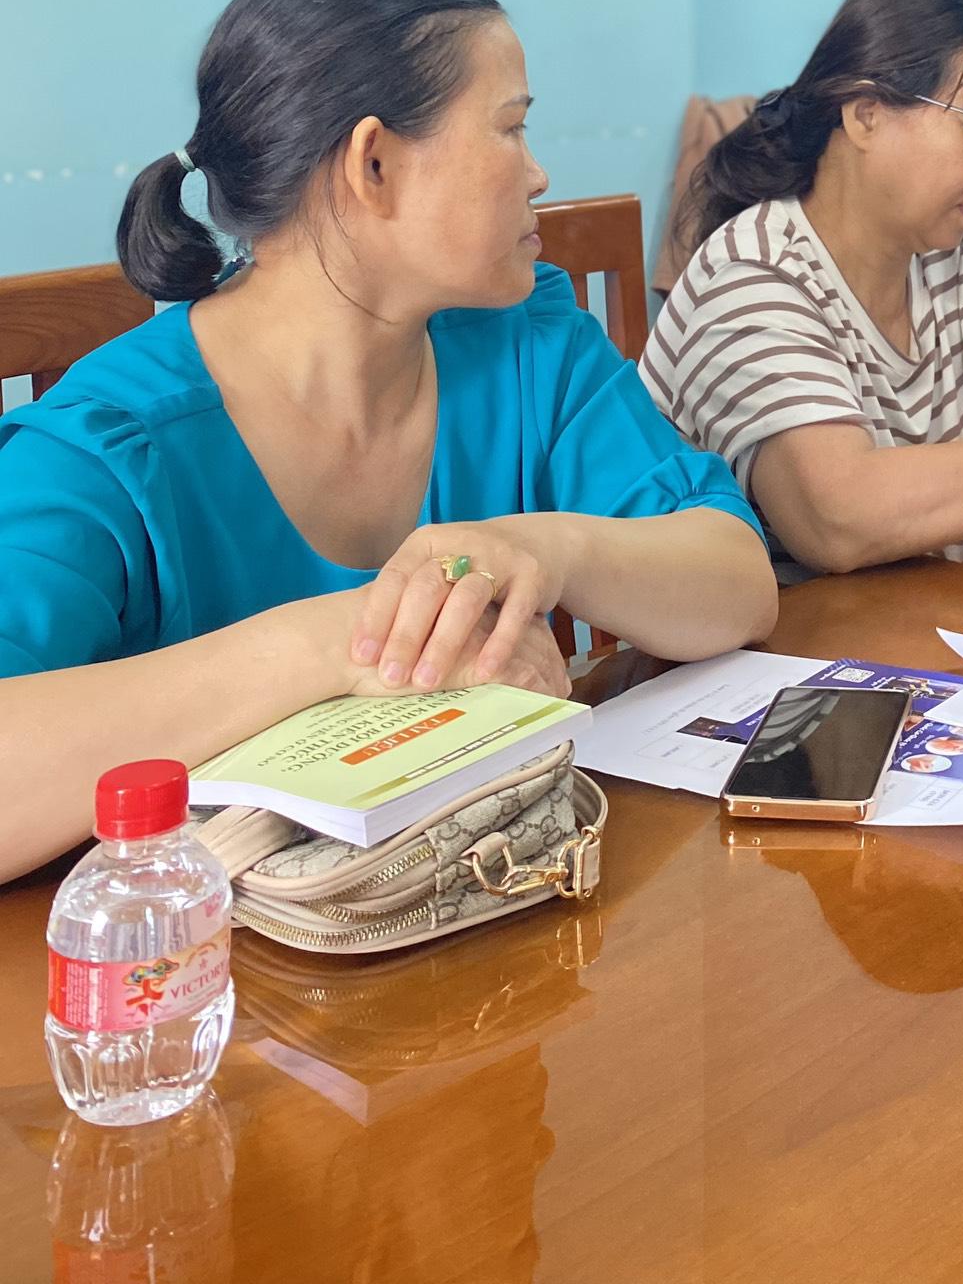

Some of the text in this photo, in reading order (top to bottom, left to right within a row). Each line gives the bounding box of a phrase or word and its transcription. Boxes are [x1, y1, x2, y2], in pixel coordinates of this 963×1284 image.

[427, 689, 474, 709] THAM
[380, 707, 428, 729] KHẢO
[170, 960, 226, 999] VICTORY
